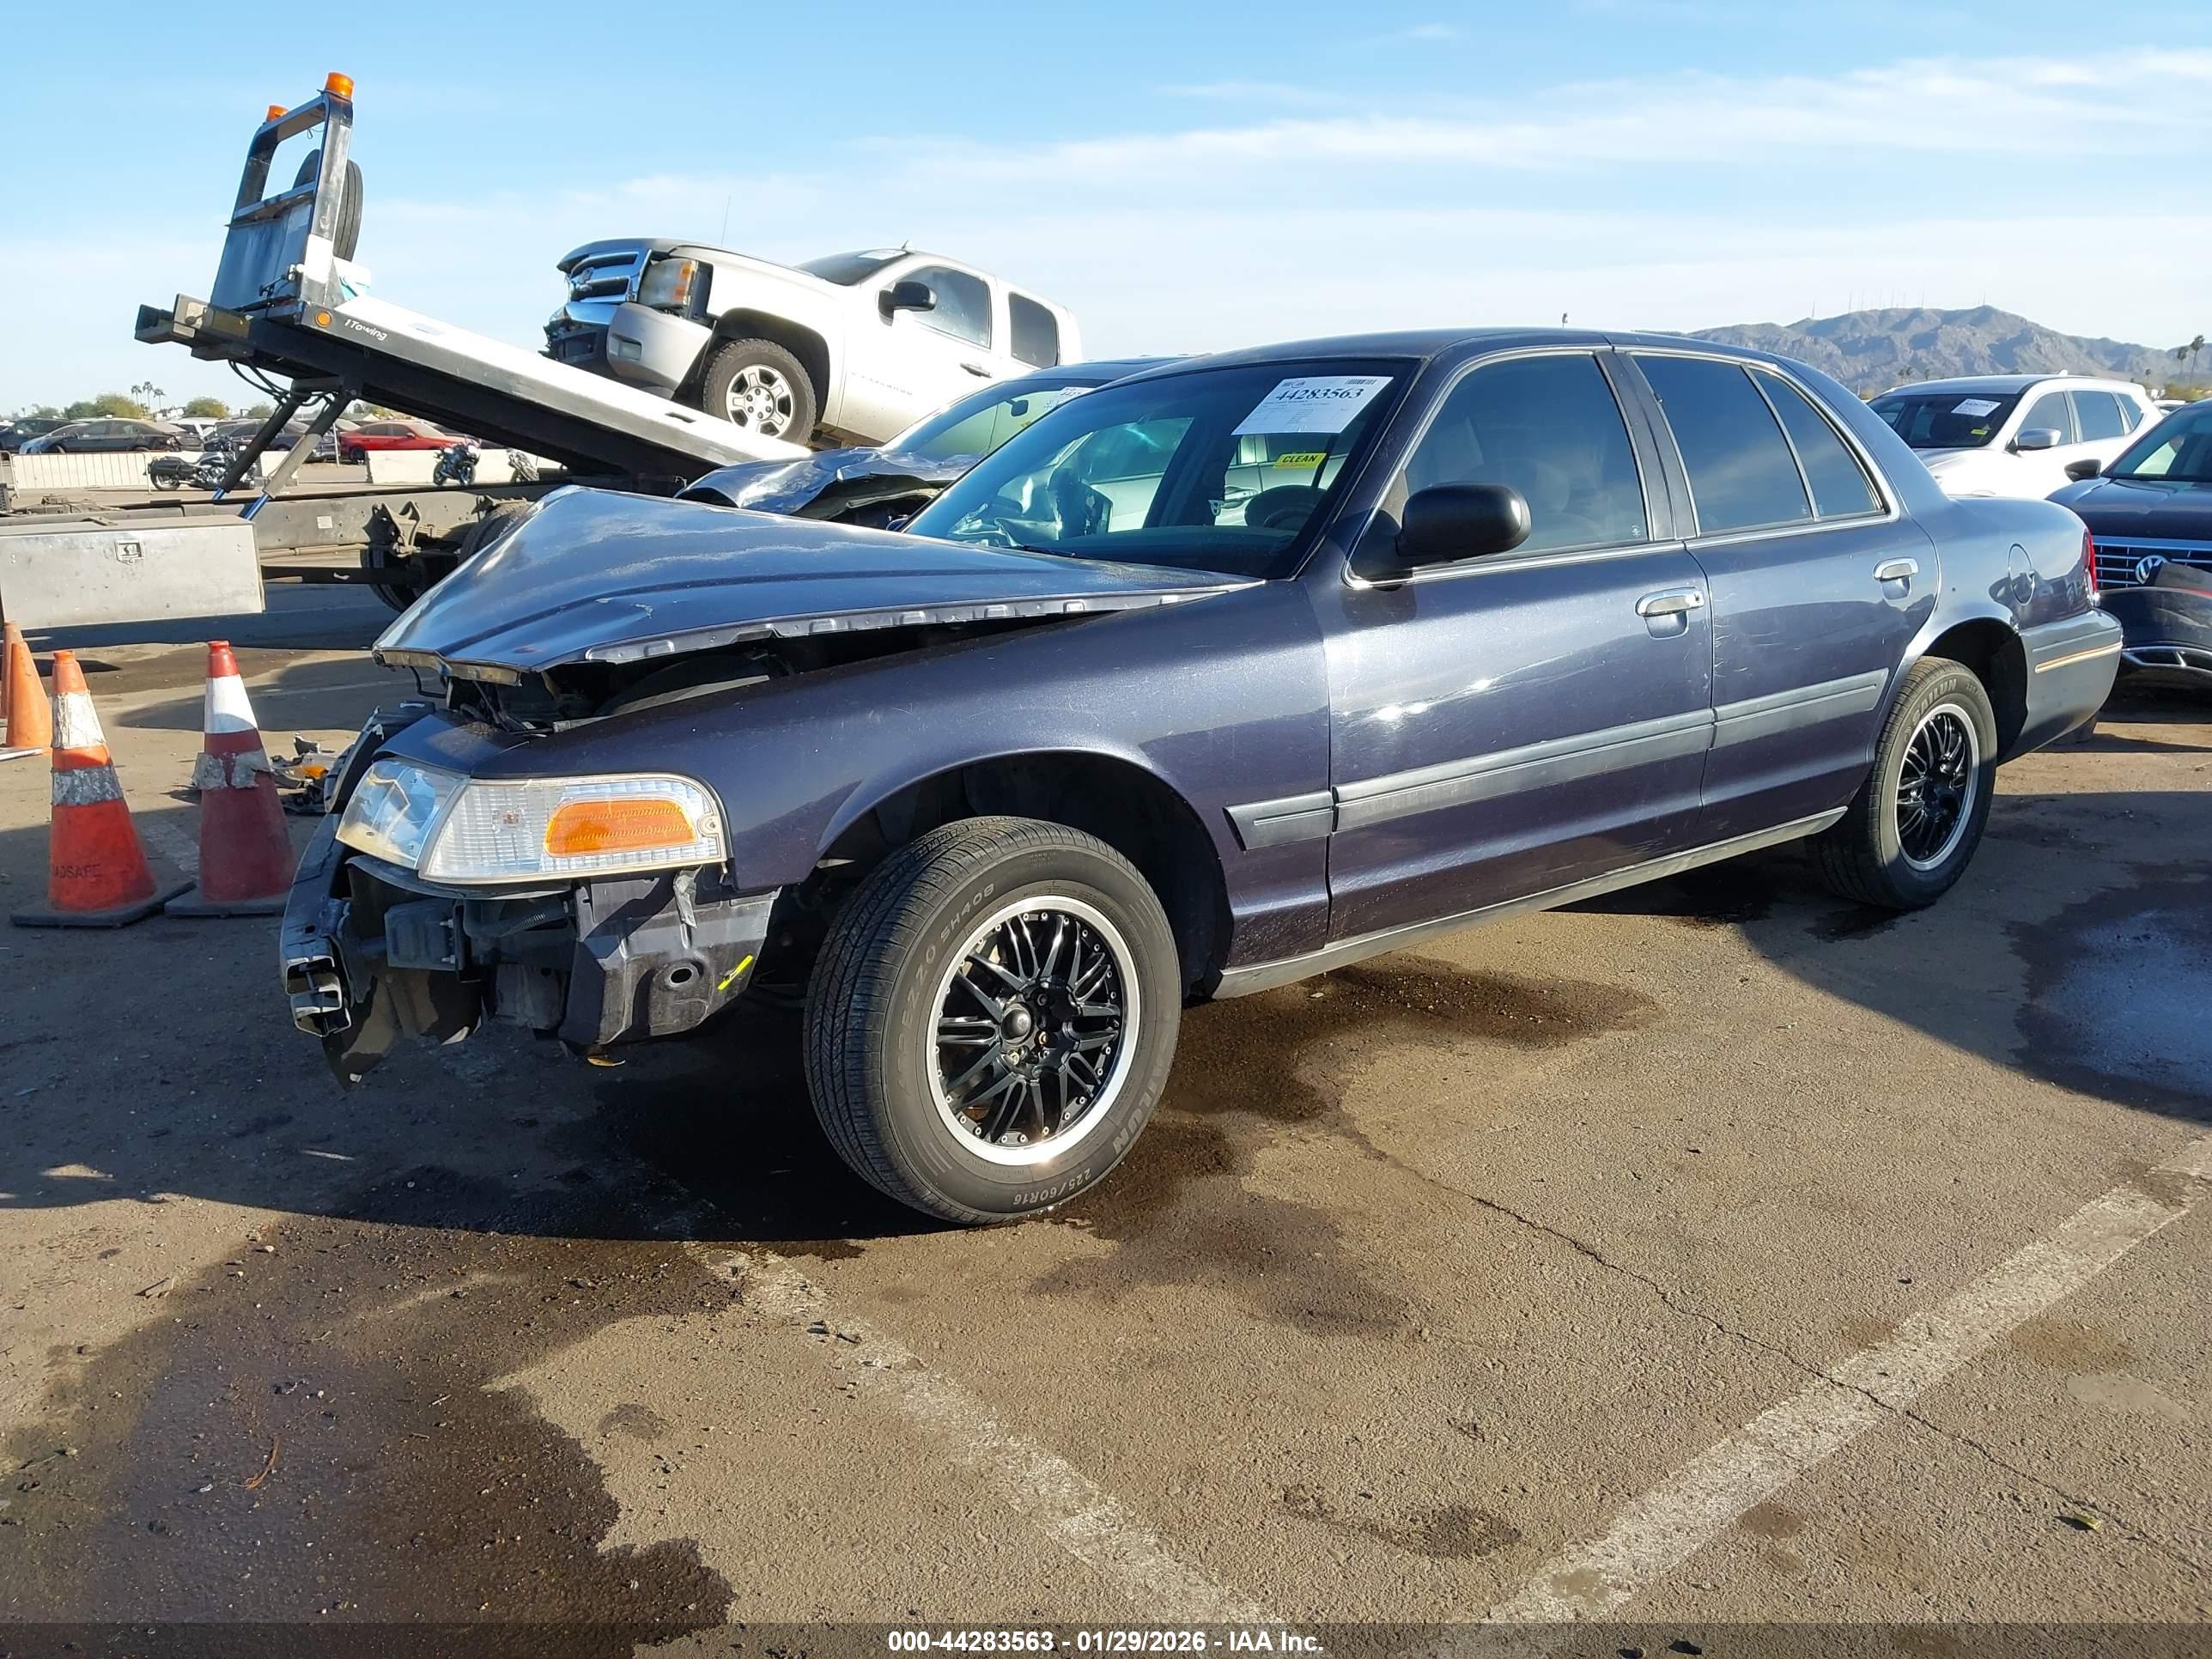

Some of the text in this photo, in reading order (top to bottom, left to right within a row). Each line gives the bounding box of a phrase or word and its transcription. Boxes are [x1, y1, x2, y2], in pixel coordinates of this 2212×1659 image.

[1275, 387, 1364, 400] 44283563
[1912, 678, 1957, 726] SAILUN
[940, 883, 995, 944] SH408
[1012, 1167, 1092, 1206] 225/60R16
